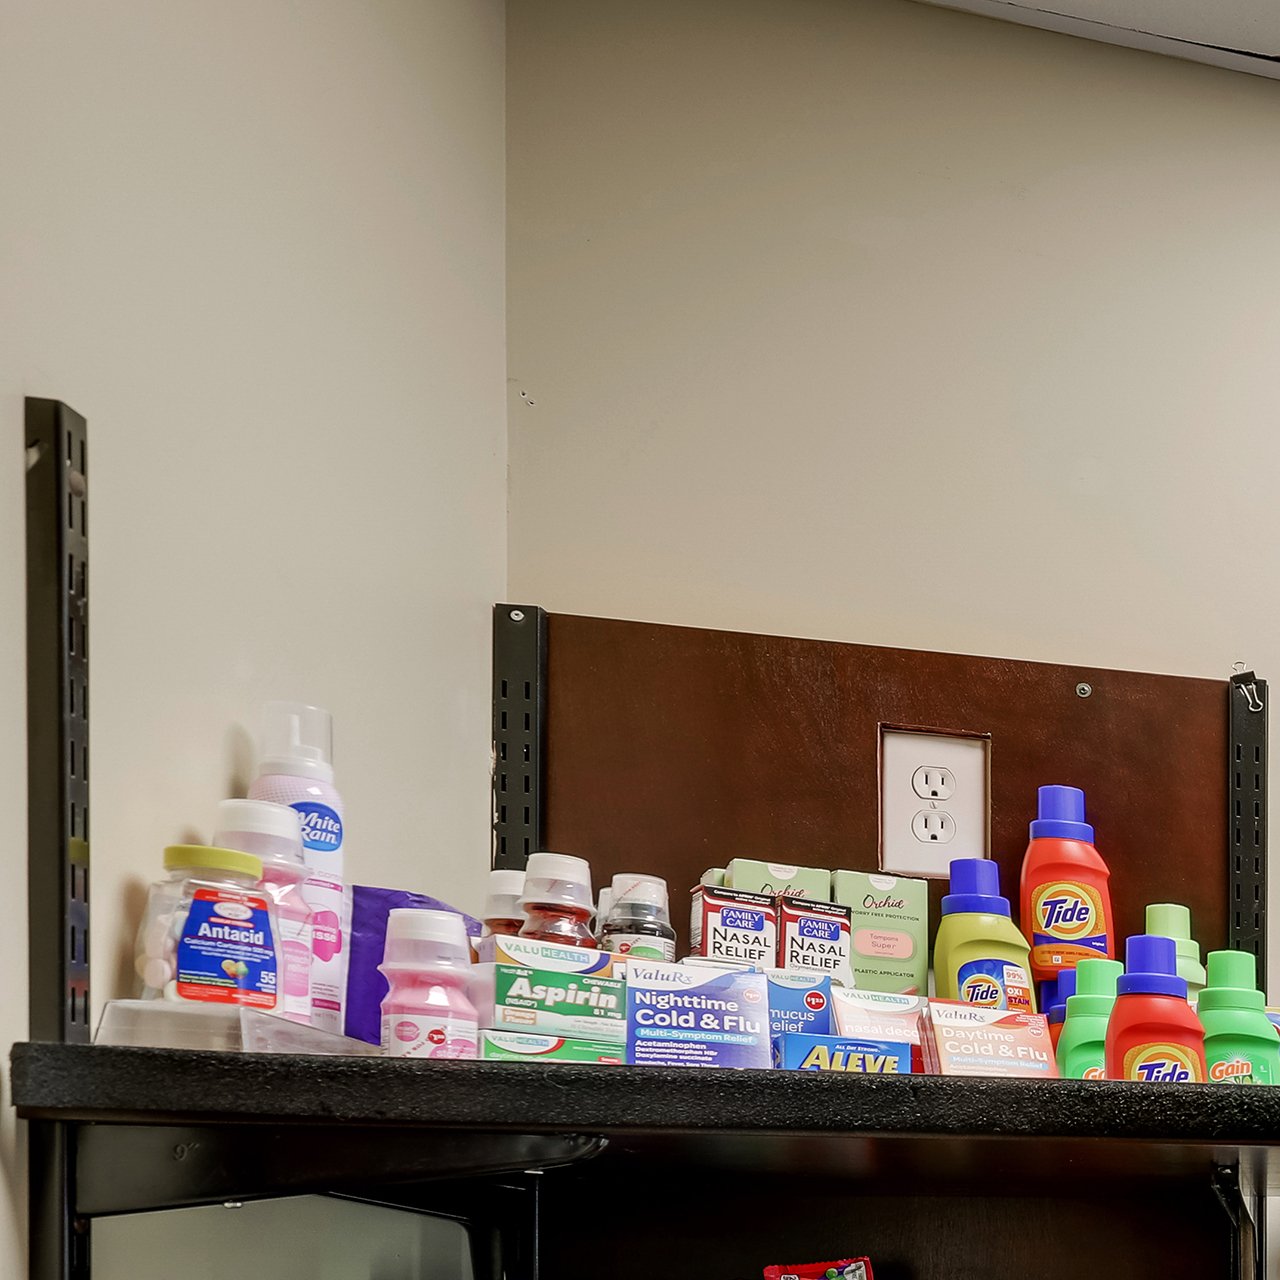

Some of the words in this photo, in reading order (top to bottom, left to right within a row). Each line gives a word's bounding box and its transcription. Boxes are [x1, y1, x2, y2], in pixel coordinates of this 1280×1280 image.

[862, 893, 905, 910] Orchid
[723, 909, 761, 922] FAMILY
[1041, 897, 1090, 930] Tide
[726, 918, 755, 929] CARE
[800, 918, 840, 932] FAMILY
[198, 922, 264, 946] Antacid
[712, 926, 771, 948] NASAL
[803, 928, 831, 939] CARE
[712, 940, 766, 961] RELIEF
[790, 936, 846, 957] NASAL
[790, 951, 841, 969] RELIEF
[260, 971, 276, 985] 55
[507, 977, 618, 1010] Aspirin
[965, 982, 999, 1003] Tide
[1007, 987, 1024, 997] OXI
[635, 991, 739, 1012] Nighttime
[1007, 996, 1030, 1007] STAIN
[635, 1008, 697, 1029] Cold
[700, 1013, 721, 1030] &
[723, 1015, 761, 1034] Flu
[640, 1028, 721, 1042] Multi-Symptom
[723, 1034, 752, 1044] Relief
[942, 1026, 1015, 1043] Daytime
[635, 1039, 707, 1050] Acetaminophen
[944, 1040, 995, 1057] Cold
[998, 1043, 1015, 1058] &
[1017, 1045, 1048, 1062] Flu
[1210, 1059, 1252, 1080] Gain
